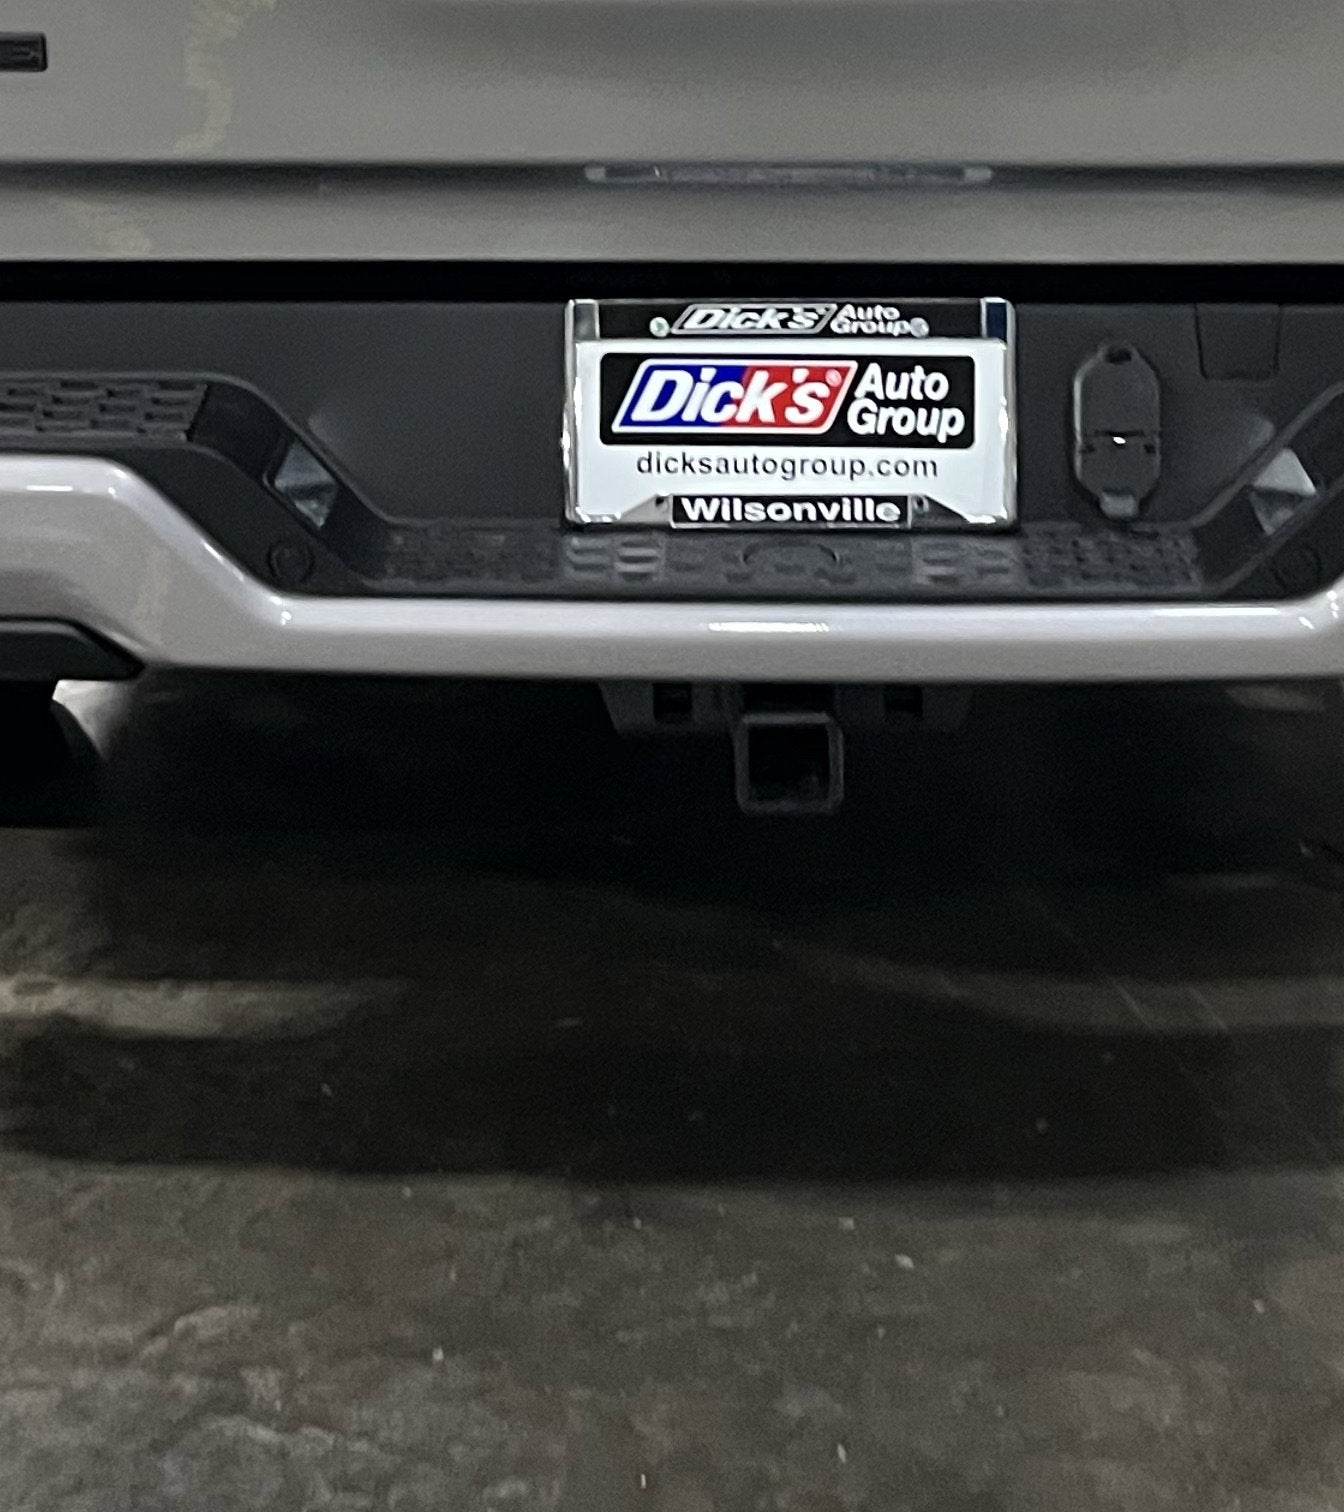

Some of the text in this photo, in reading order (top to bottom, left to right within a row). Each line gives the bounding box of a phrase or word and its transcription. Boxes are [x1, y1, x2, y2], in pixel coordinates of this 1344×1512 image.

[682, 304, 901, 330] Dick's Auto
[830, 319, 912, 337] Group
[630, 362, 950, 424] Dick's Auto
[847, 399, 965, 443] Group
[636, 452, 939, 481] dicksautogroup.com
[681, 497, 902, 523] Wilsonville
